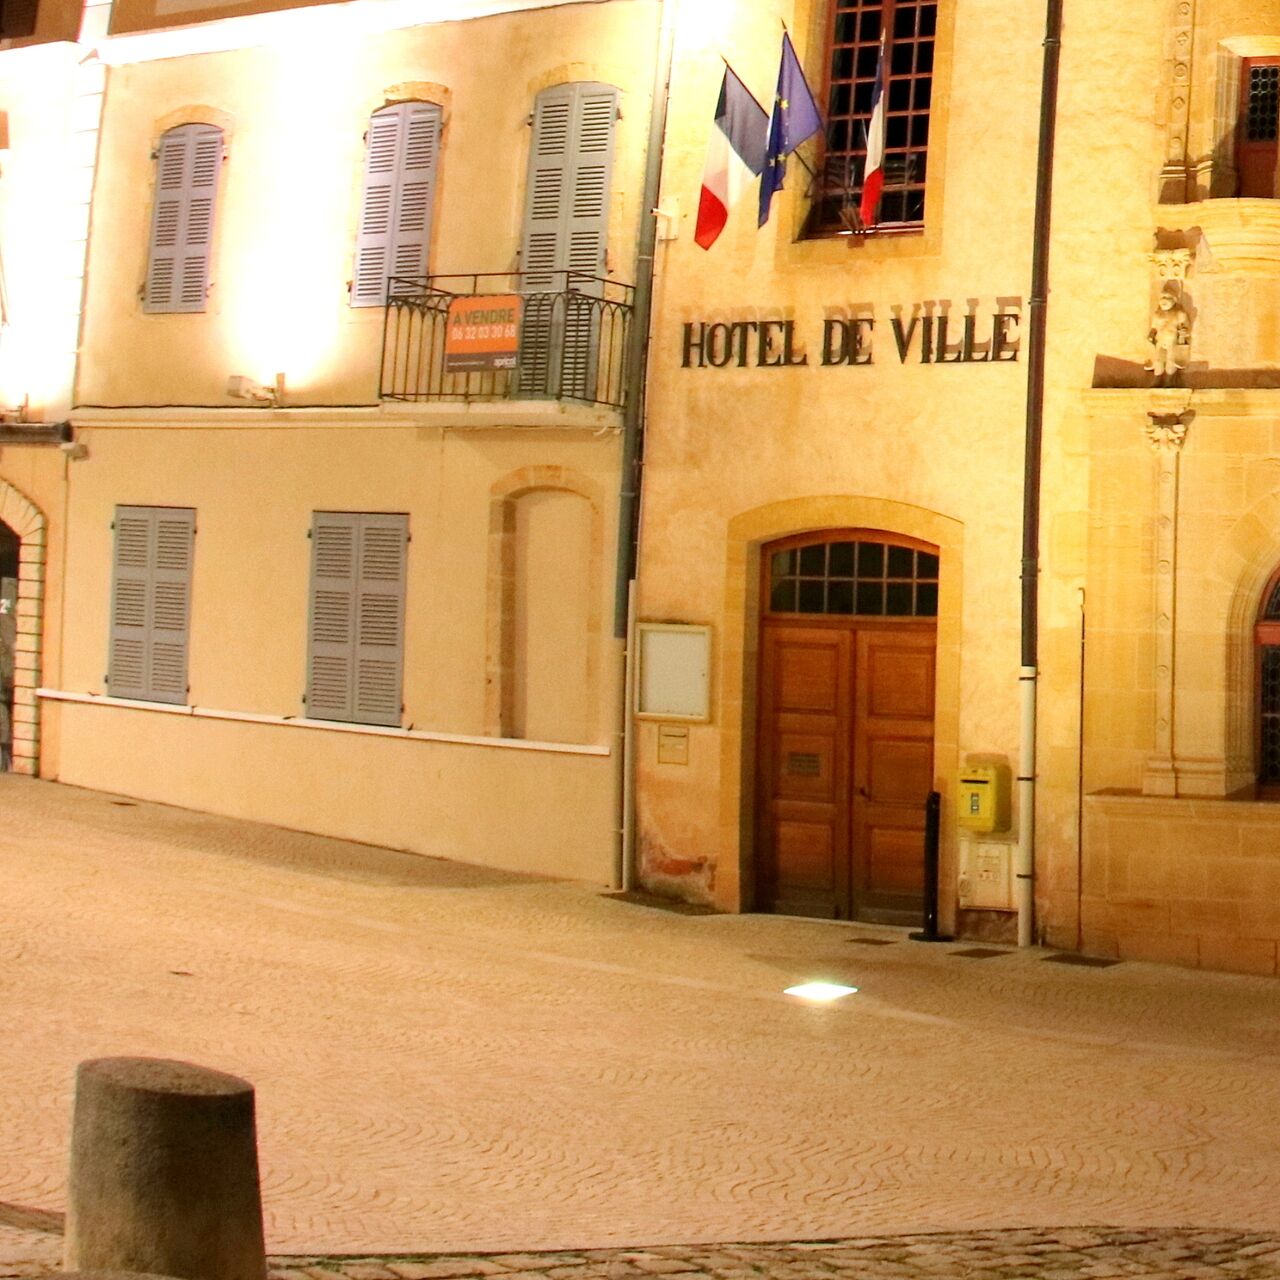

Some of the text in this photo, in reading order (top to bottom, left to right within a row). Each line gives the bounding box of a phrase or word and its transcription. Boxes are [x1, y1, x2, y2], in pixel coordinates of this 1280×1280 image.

[464, 308, 515, 325] VENDRE
[680, 313, 1021, 368] HOTEL DE VILLE
